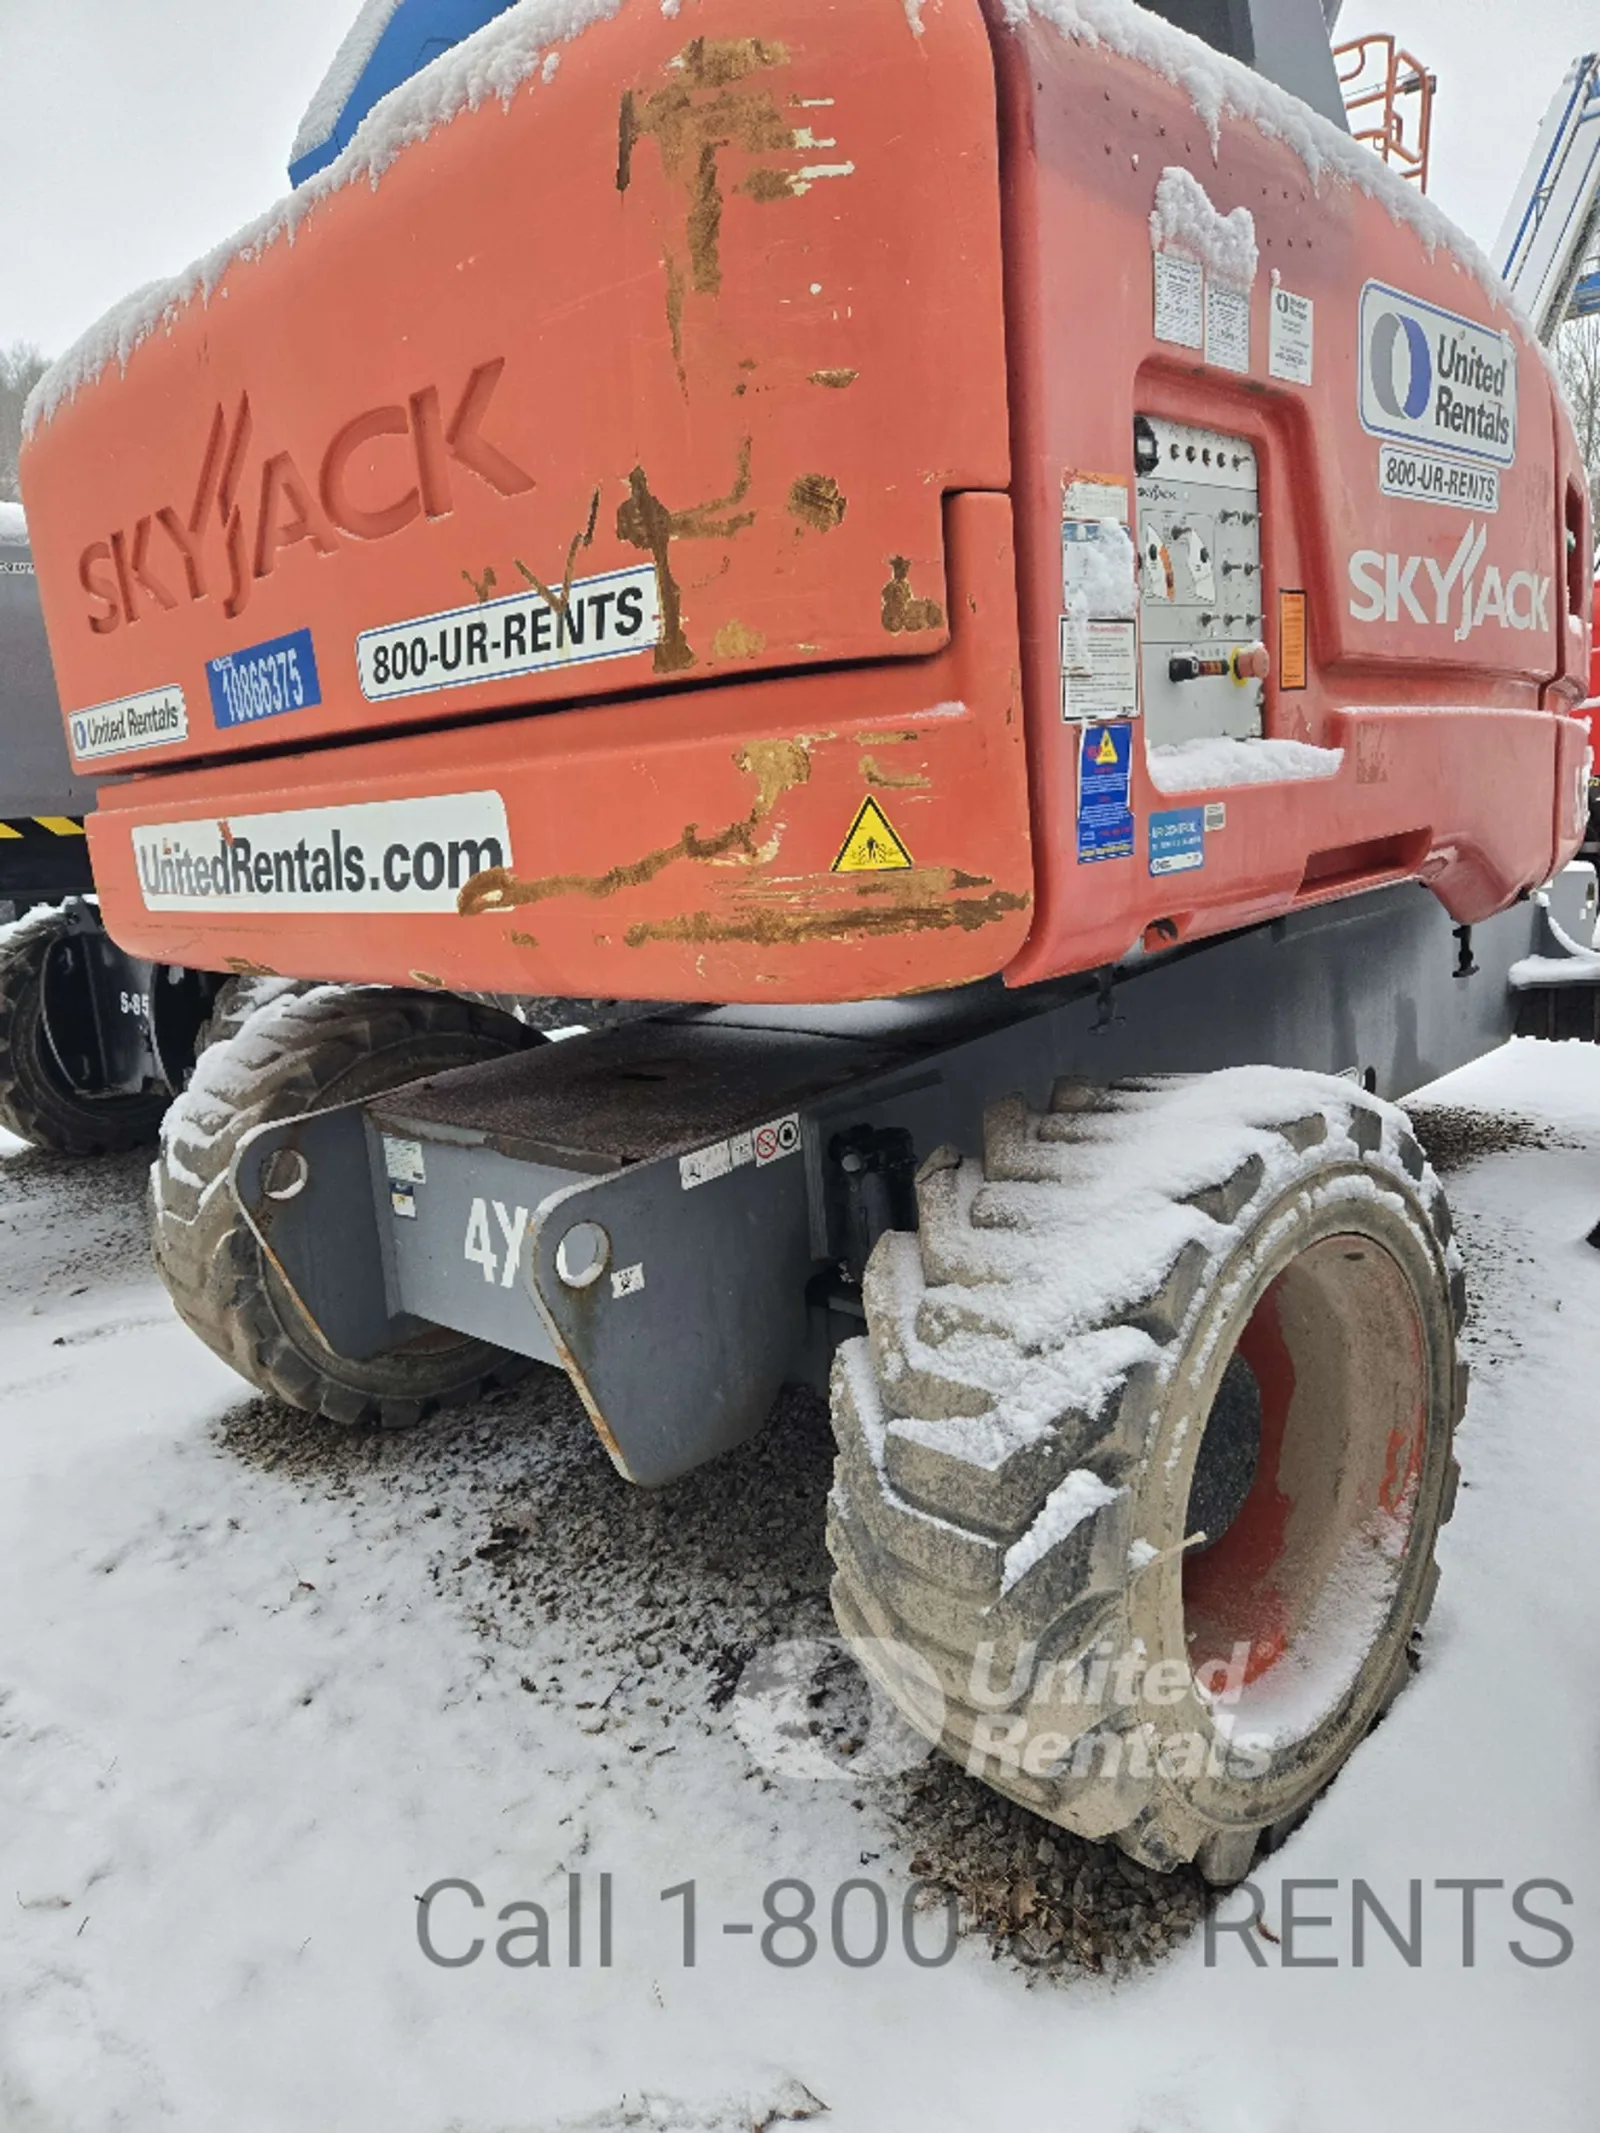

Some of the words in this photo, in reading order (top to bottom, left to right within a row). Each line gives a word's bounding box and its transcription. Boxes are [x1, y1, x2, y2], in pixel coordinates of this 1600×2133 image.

[1436, 333, 1508, 397] United
[1434, 384, 1510, 446] Rentals
[79, 355, 536, 634] SKYJACK
[1385, 457, 1496, 502] 800-UR-RENTS
[1348, 520, 1551, 643] SKYJACK
[372, 586, 644, 685] 800-UR-RENTS
[222, 648, 304, 722] 10866375
[87, 710, 127, 747] United
[127, 698, 179, 737] Rentals
[140, 828, 503, 896] UnitedRentals.com
